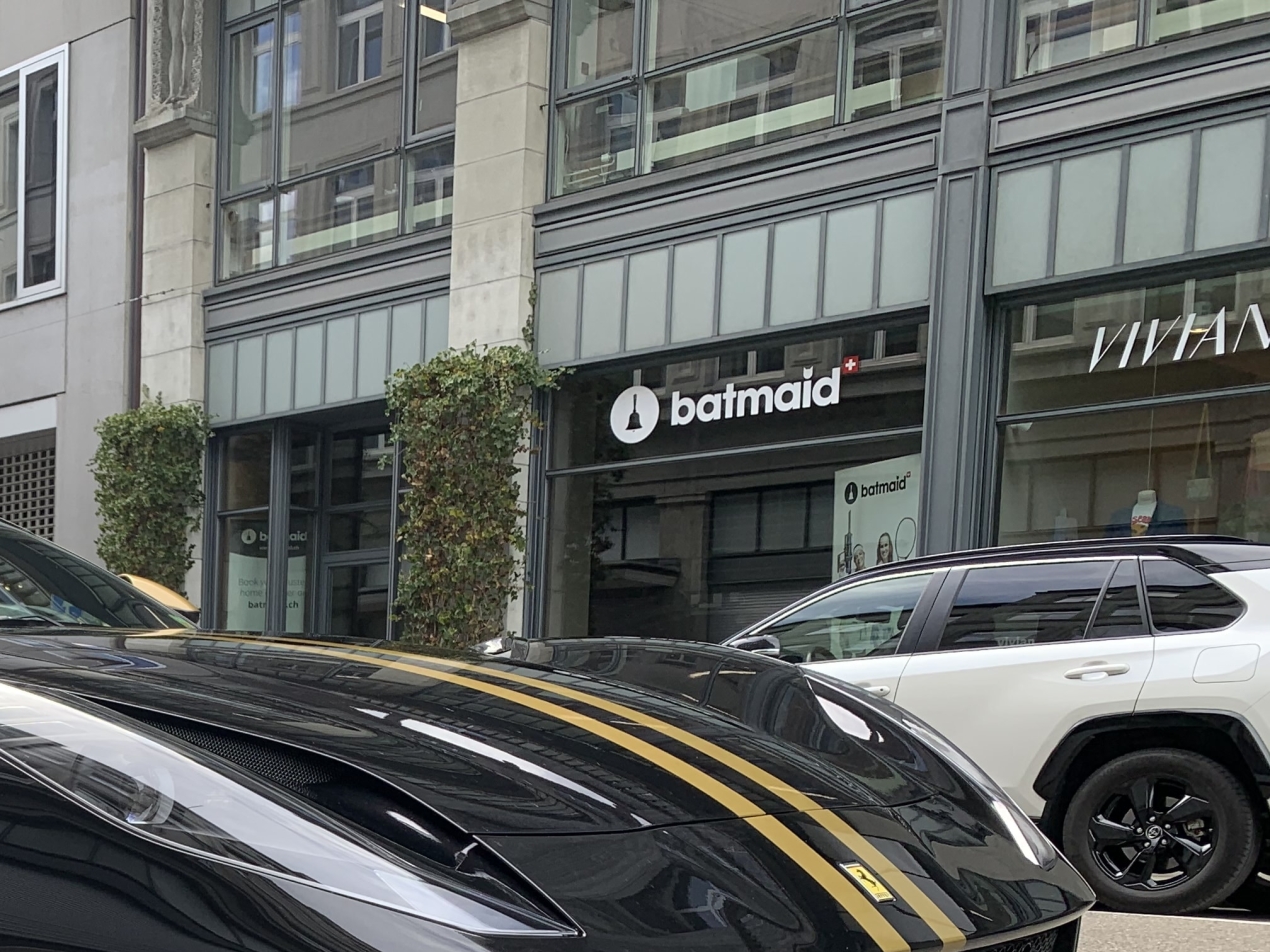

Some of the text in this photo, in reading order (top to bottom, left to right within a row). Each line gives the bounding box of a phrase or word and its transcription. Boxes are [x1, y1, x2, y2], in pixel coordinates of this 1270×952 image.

[1089, 303, 1270, 373] VIVIAN
[671, 366, 841, 426] batmaid
[861, 475, 907, 498] batmaid
[238, 577, 258, 587] Book
[240, 589, 263, 597] home
